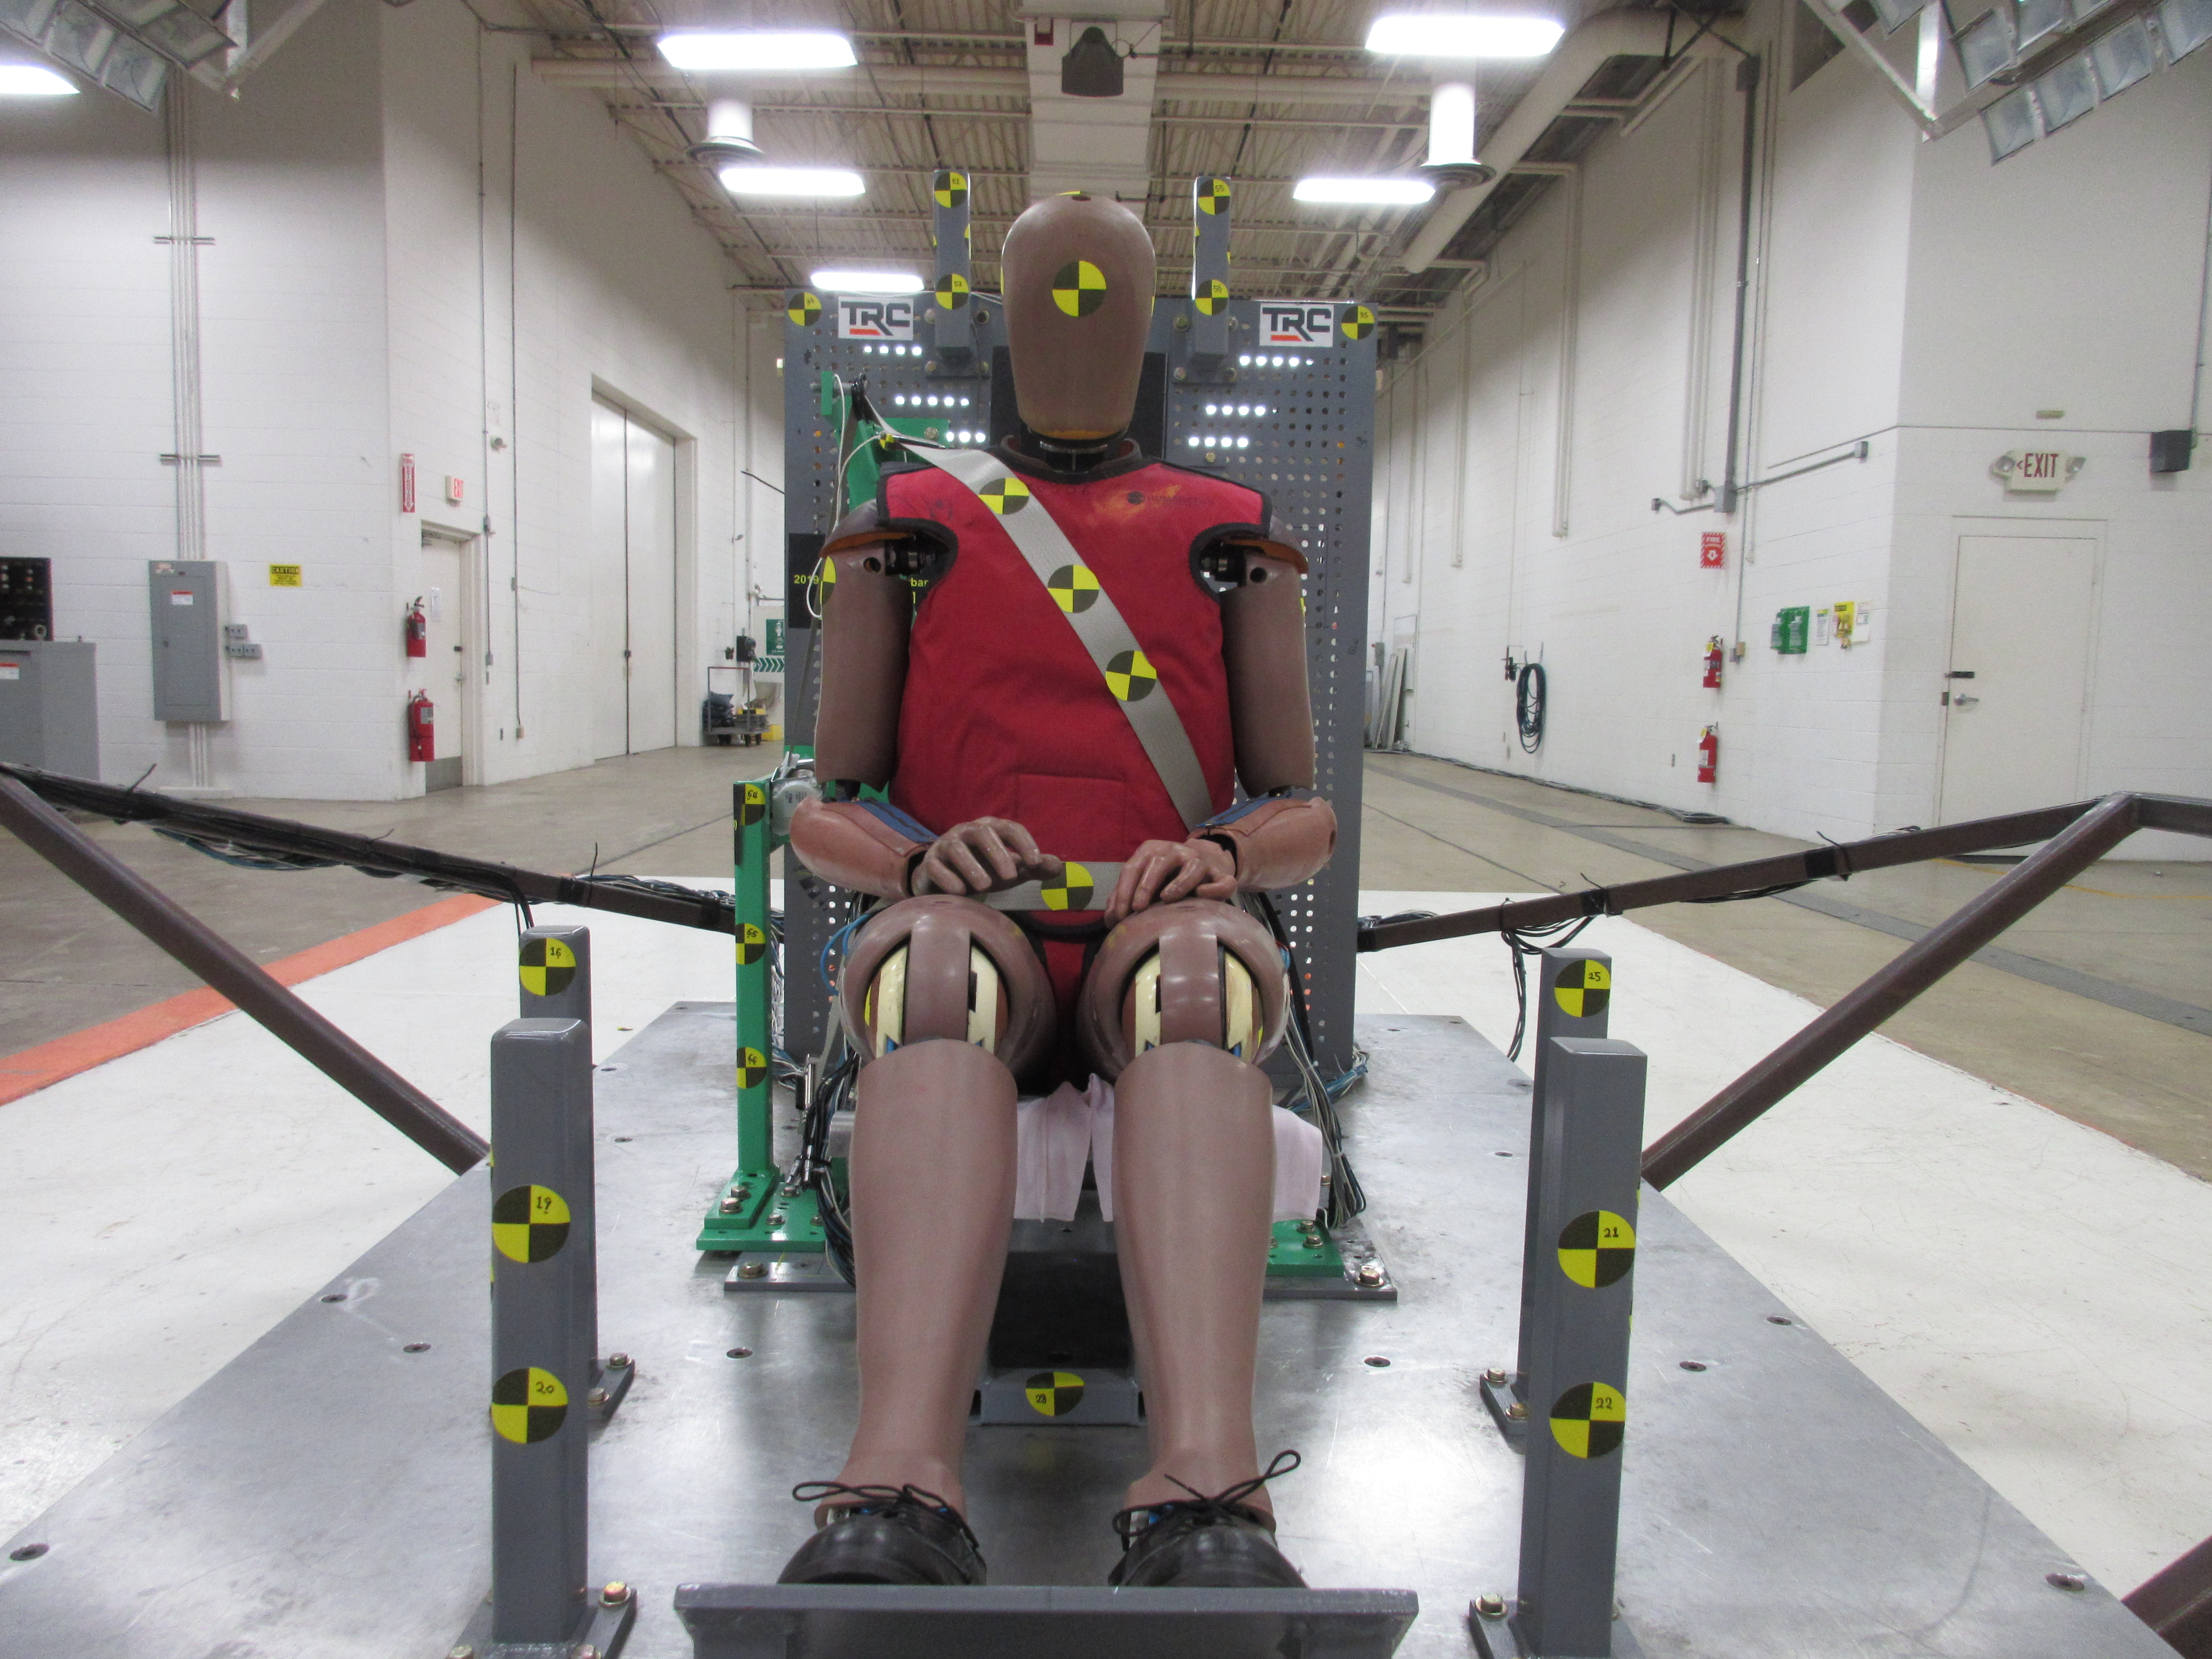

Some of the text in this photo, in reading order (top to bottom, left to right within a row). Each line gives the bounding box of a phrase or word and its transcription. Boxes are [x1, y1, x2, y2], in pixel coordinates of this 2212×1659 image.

[840, 301, 911, 336] TRC
[1262, 307, 1332, 342] TRC
[2023, 453, 2059, 478] EXIT
[793, 575, 819, 585] 2019
[747, 928, 758, 938] 65
[550, 946, 562, 957] 16
[1588, 972, 1601, 981] 25
[537, 1195, 552, 1212] 19
[1603, 1227, 1619, 1238] 21
[536, 1381, 555, 1394] 20
[1596, 1397, 1613, 1409] 22
